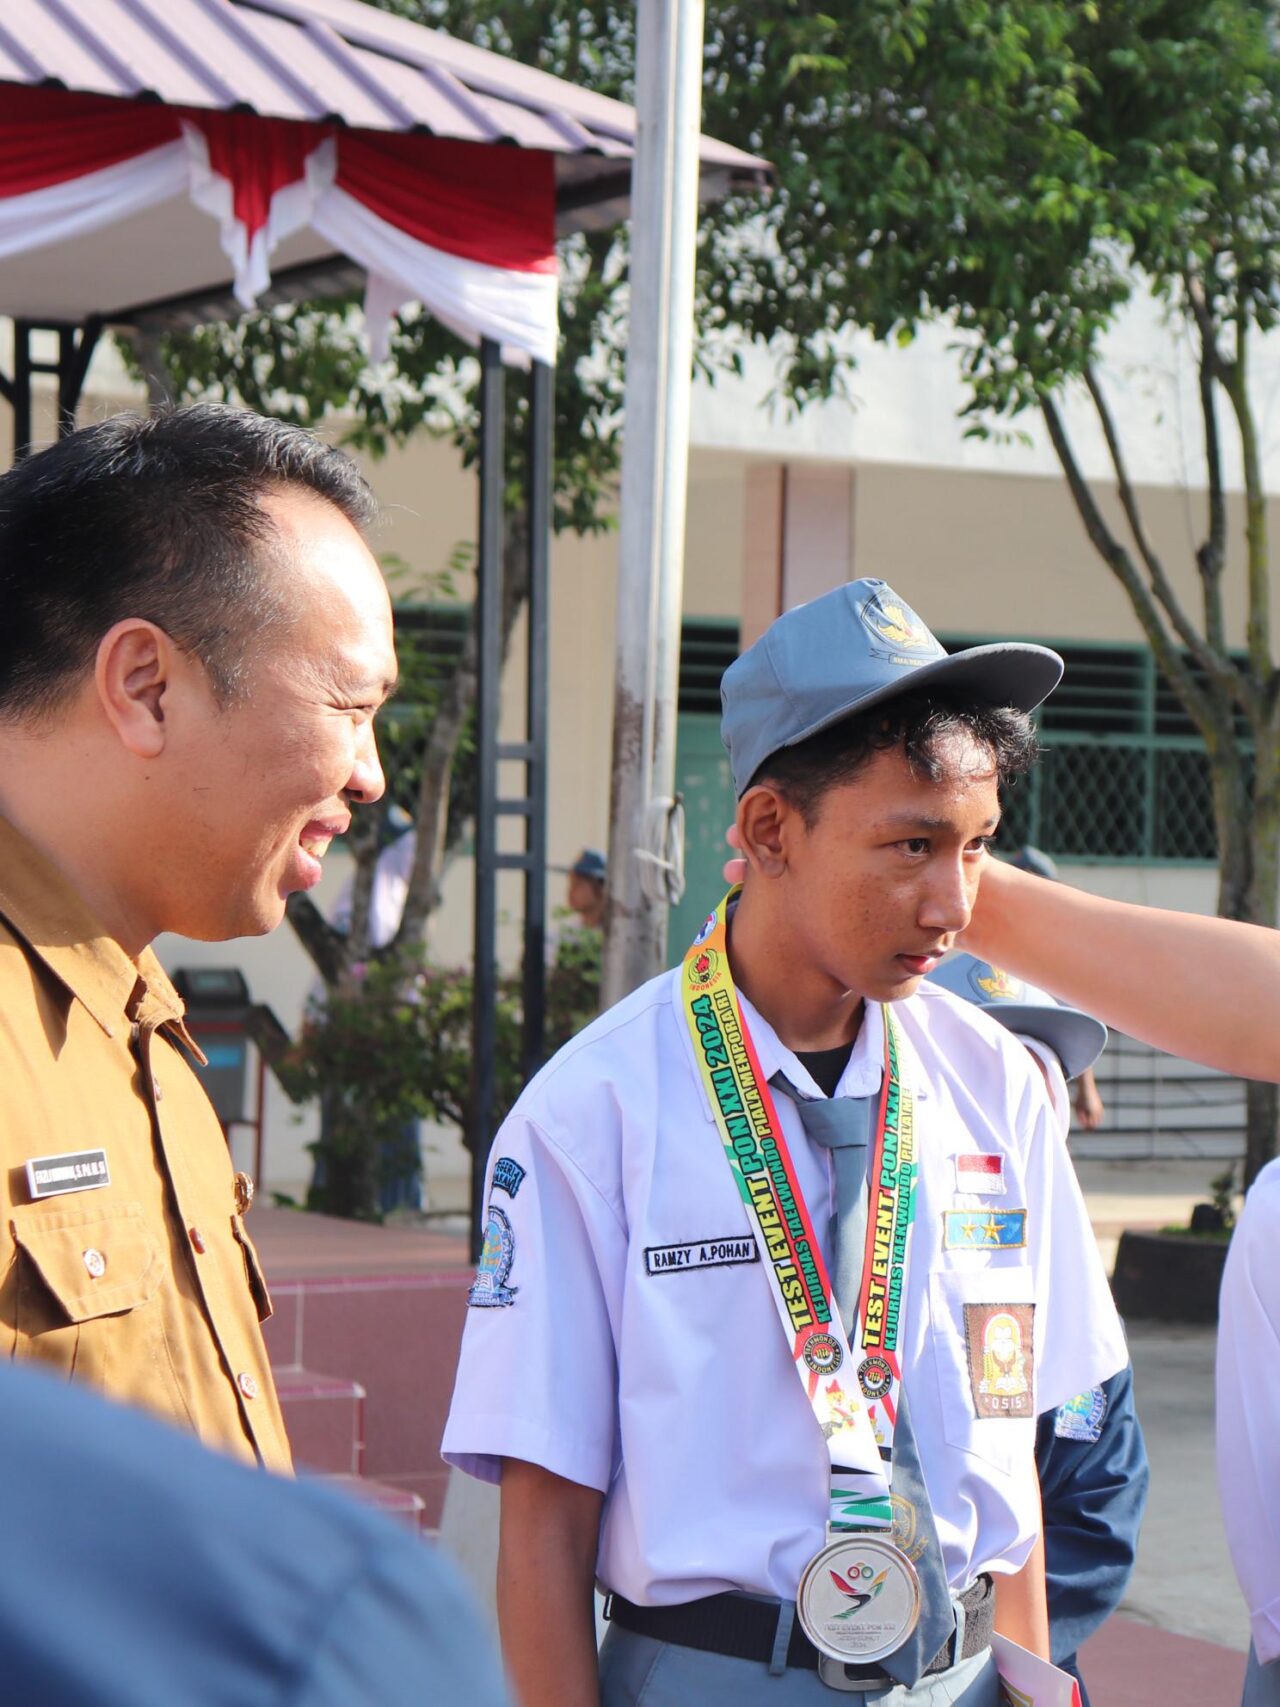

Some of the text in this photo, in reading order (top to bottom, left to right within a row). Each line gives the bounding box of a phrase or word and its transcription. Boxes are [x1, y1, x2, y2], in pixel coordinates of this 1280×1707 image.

[689, 972, 722, 991] INDONESIA
[885, 1081, 900, 1131] XXI
[690, 994, 813, 1332] TEST EVENT PON XXI 2024
[713, 989, 832, 1324] KEJURNAS TAEKWONDO PIALA MENPORA RI
[880, 1131, 898, 1190] PON
[900, 1114, 912, 1162] PIALA
[871, 1189, 895, 1277] EVENT
[892, 1162, 912, 1265] TAEKWONDO
[654, 1250, 691, 1267] RAMZY
[861, 1278, 886, 1350] TEST
[884, 1265, 903, 1351] KEJURNAS
[809, 1353, 841, 1373] INDONESIA
[992, 1396, 1022, 1409] OSIS
